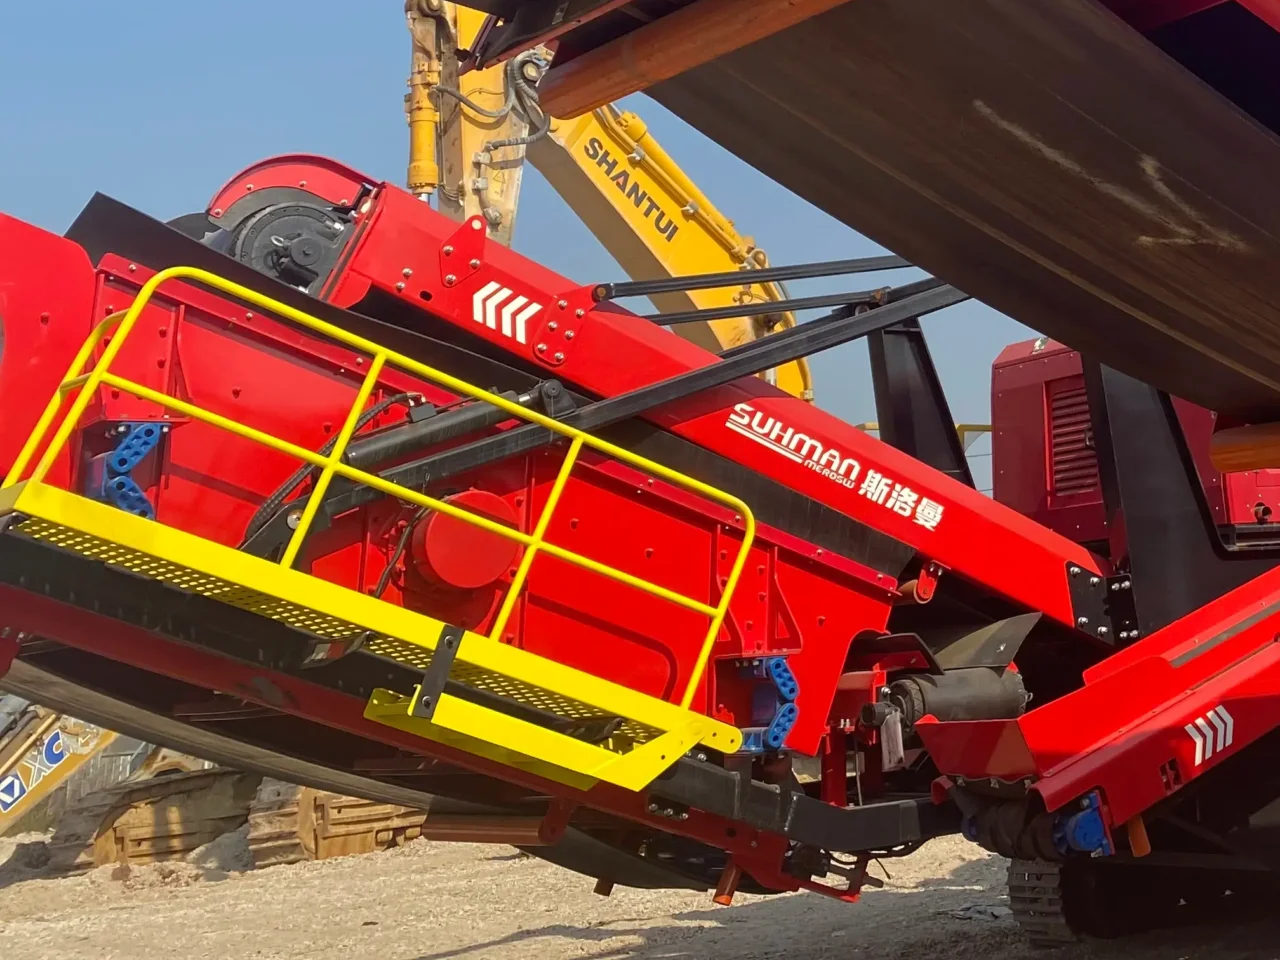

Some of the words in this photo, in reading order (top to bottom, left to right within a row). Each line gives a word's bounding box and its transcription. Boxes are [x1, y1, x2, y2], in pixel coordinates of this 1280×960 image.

[584, 137, 680, 243] SHANTUI
[728, 403, 861, 480] SUHMAN
[804, 460, 855, 489] MEROSW
[858, 468, 945, 532] 斯洛曼
